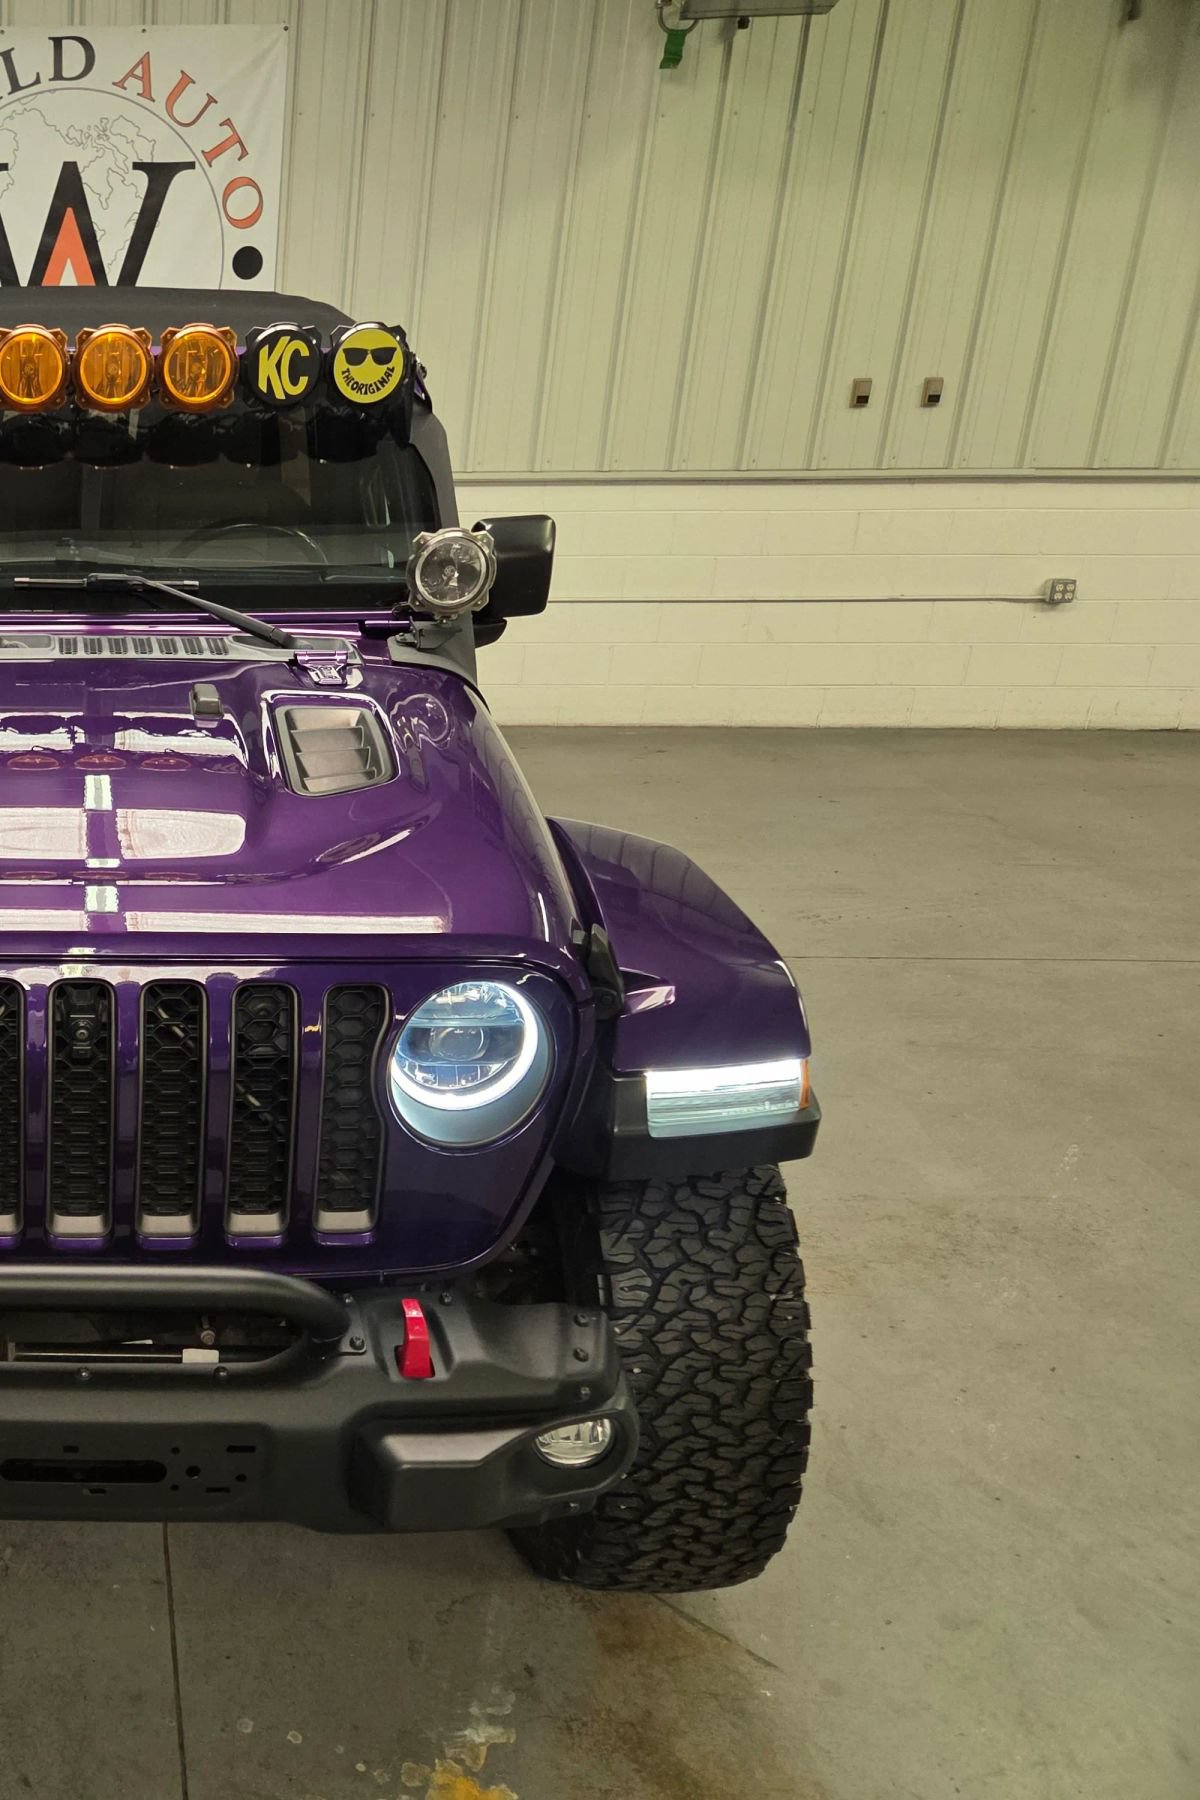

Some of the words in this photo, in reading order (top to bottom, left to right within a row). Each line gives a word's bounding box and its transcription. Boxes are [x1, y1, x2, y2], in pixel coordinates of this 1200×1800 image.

[112, 51, 264, 229] AUTO
[258, 336, 308, 400] KC
[341, 367, 355, 387] THE
[350, 366, 396, 396] ORIGINAL
